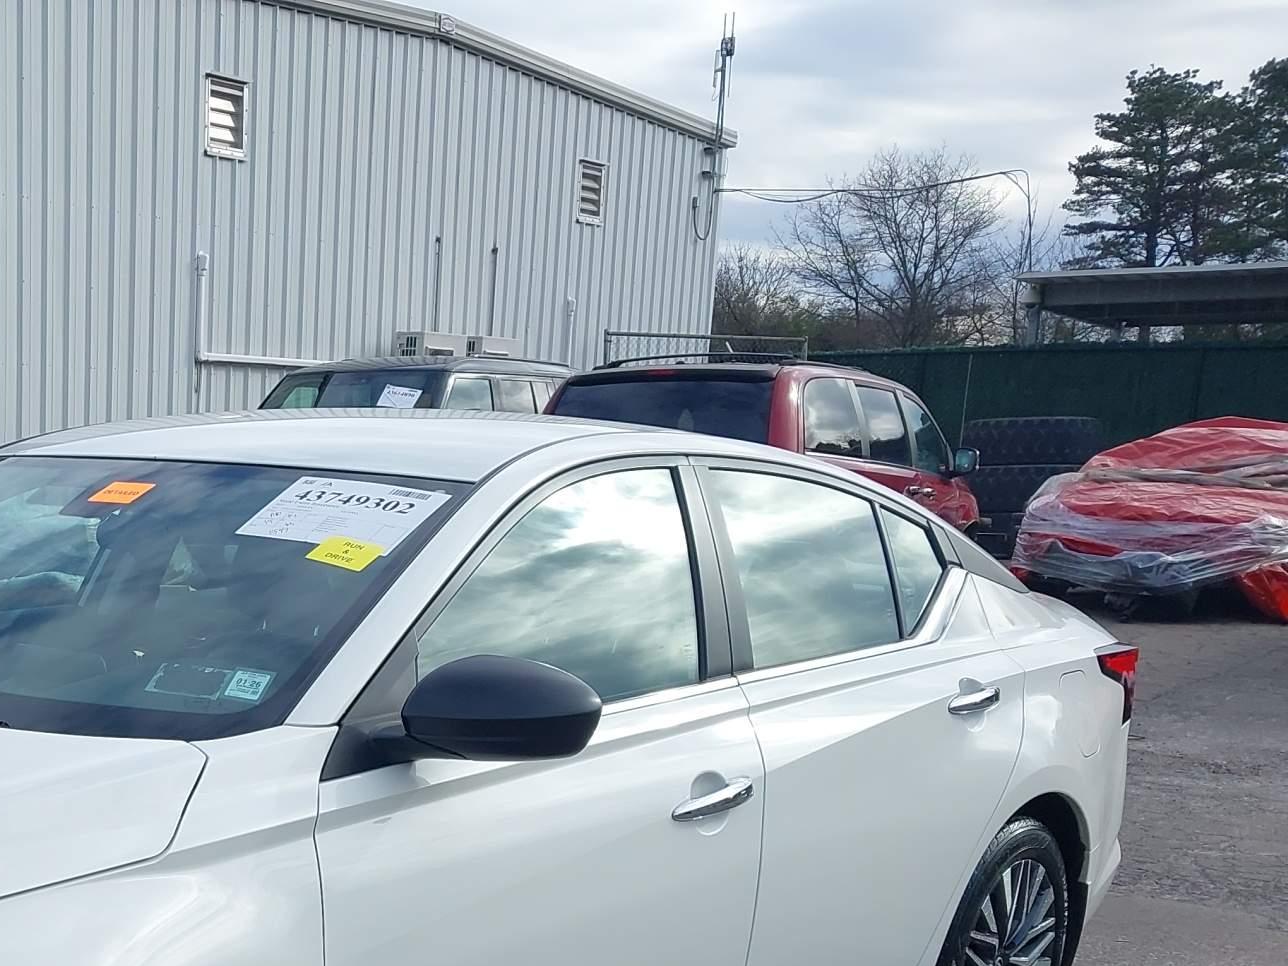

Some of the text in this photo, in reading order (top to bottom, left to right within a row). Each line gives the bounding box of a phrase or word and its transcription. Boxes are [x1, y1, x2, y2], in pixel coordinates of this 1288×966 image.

[294, 489, 416, 515] 43749302
[343, 541, 366, 551] RUN
[324, 552, 355, 564] DRIVE
